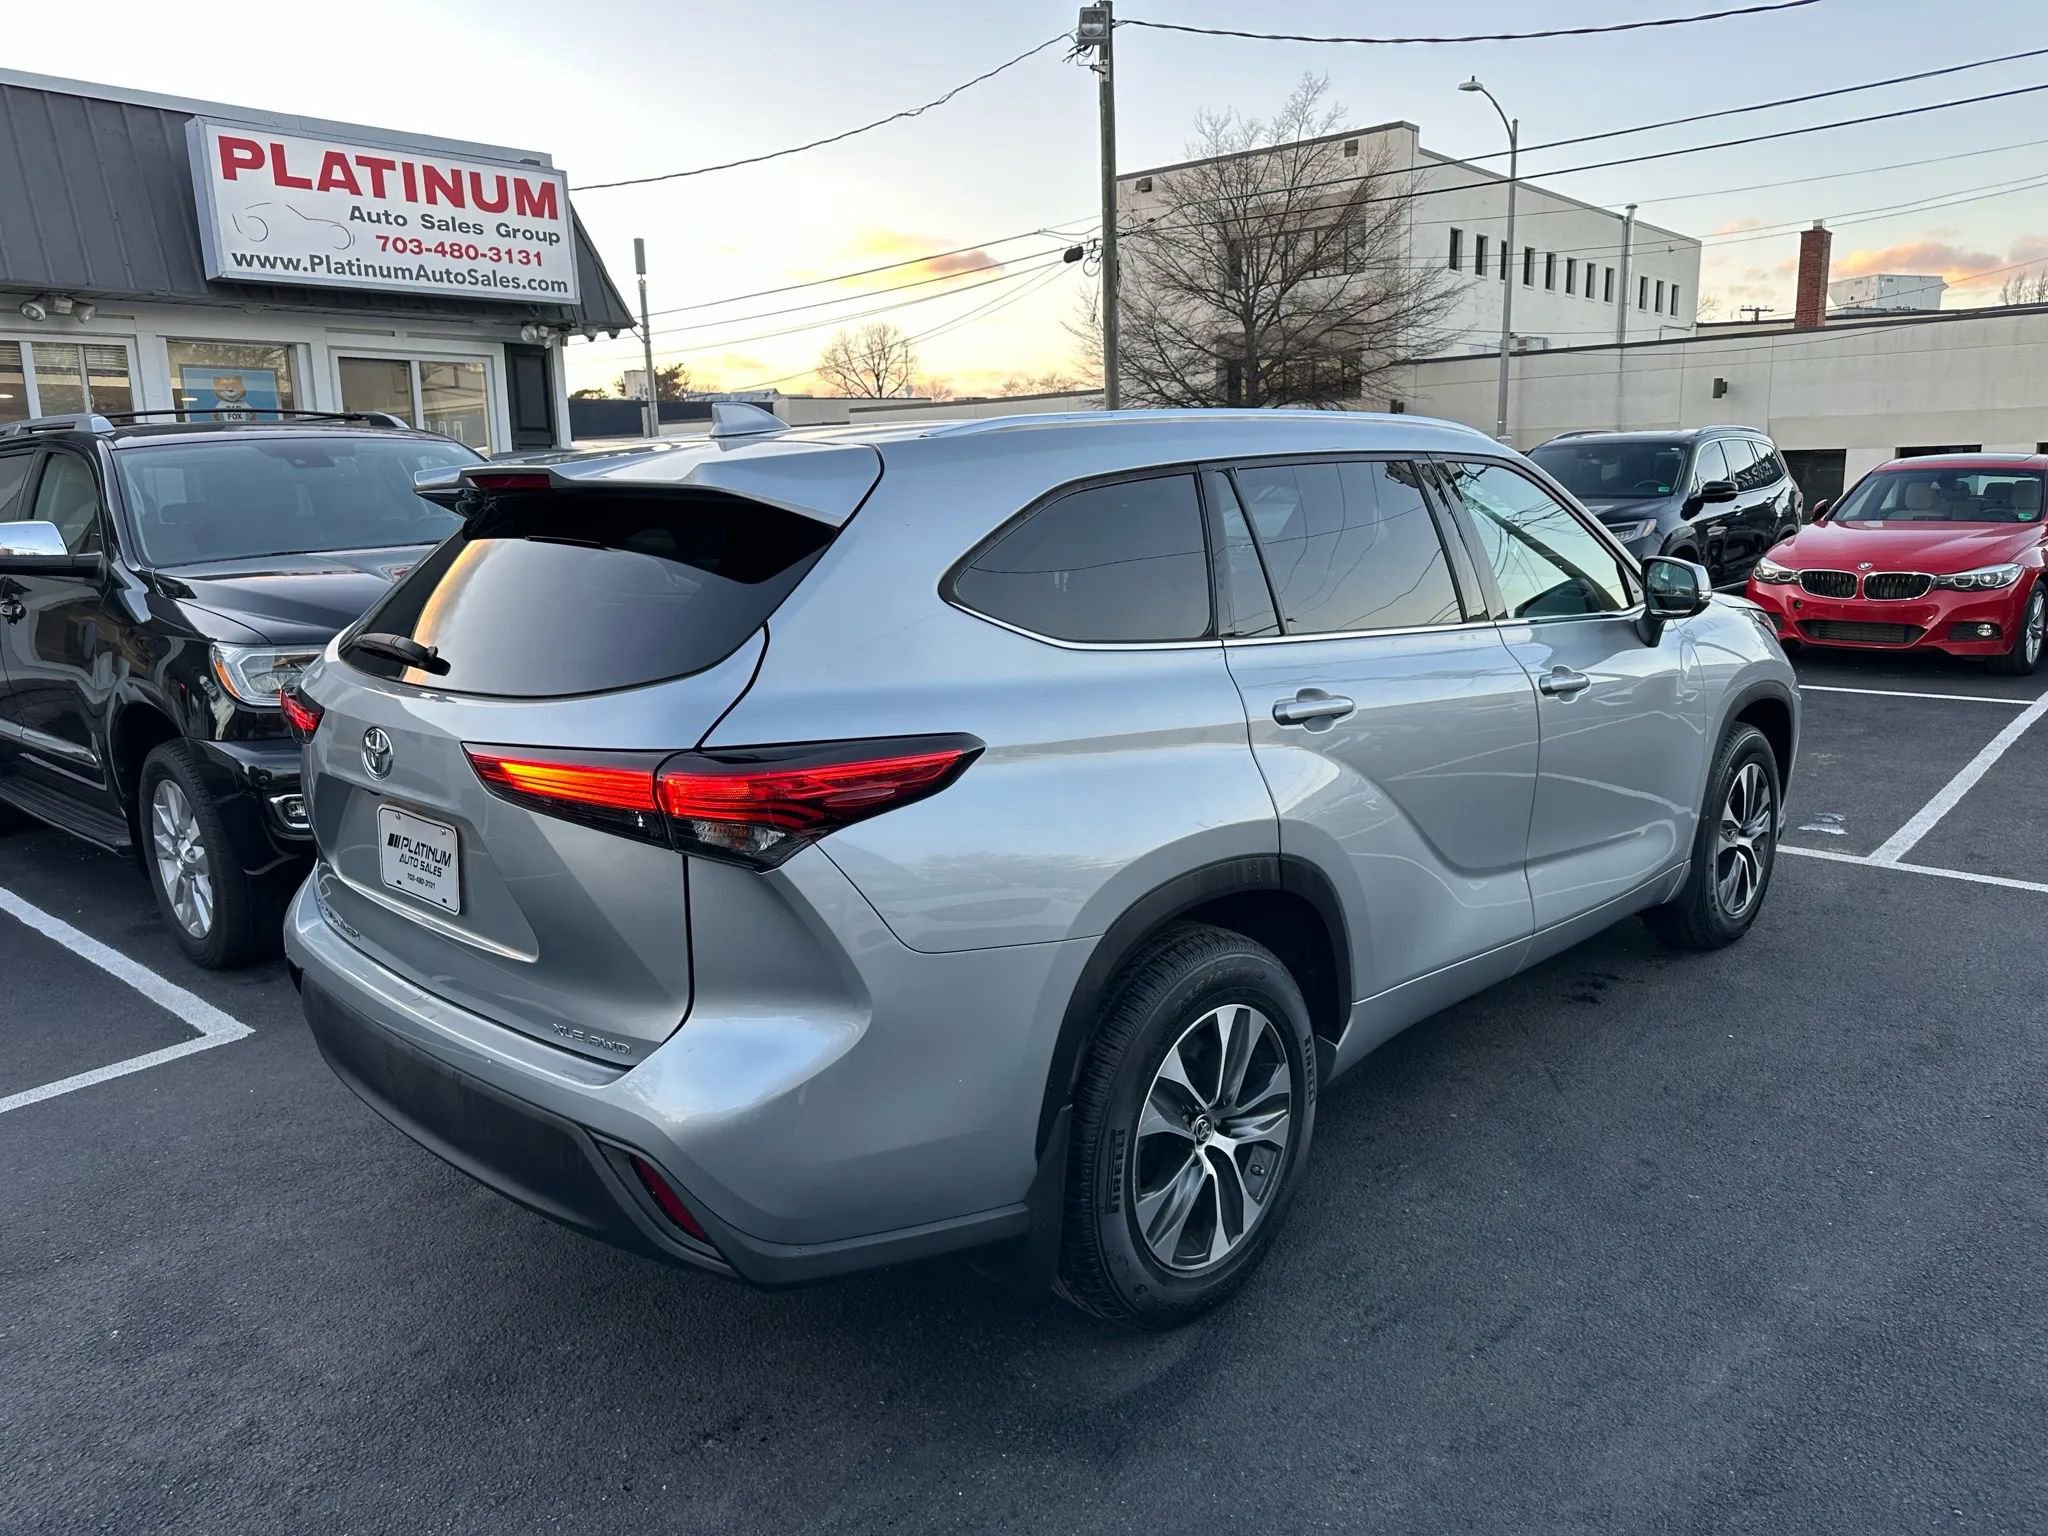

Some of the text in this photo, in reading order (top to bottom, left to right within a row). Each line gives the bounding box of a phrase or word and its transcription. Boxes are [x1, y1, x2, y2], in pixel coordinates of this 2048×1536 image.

[218, 135, 559, 220] PLATINUM
[349, 205, 561, 246] Auto Sales Group
[375, 235, 543, 267] 703-480-3131
[231, 251, 568, 293] www.PlatinumAutoSales.com
[399, 853, 442, 878] AUTO SALES
[400, 836, 452, 868] PLATINUM
[553, 1023, 632, 1056] XLE AWD
